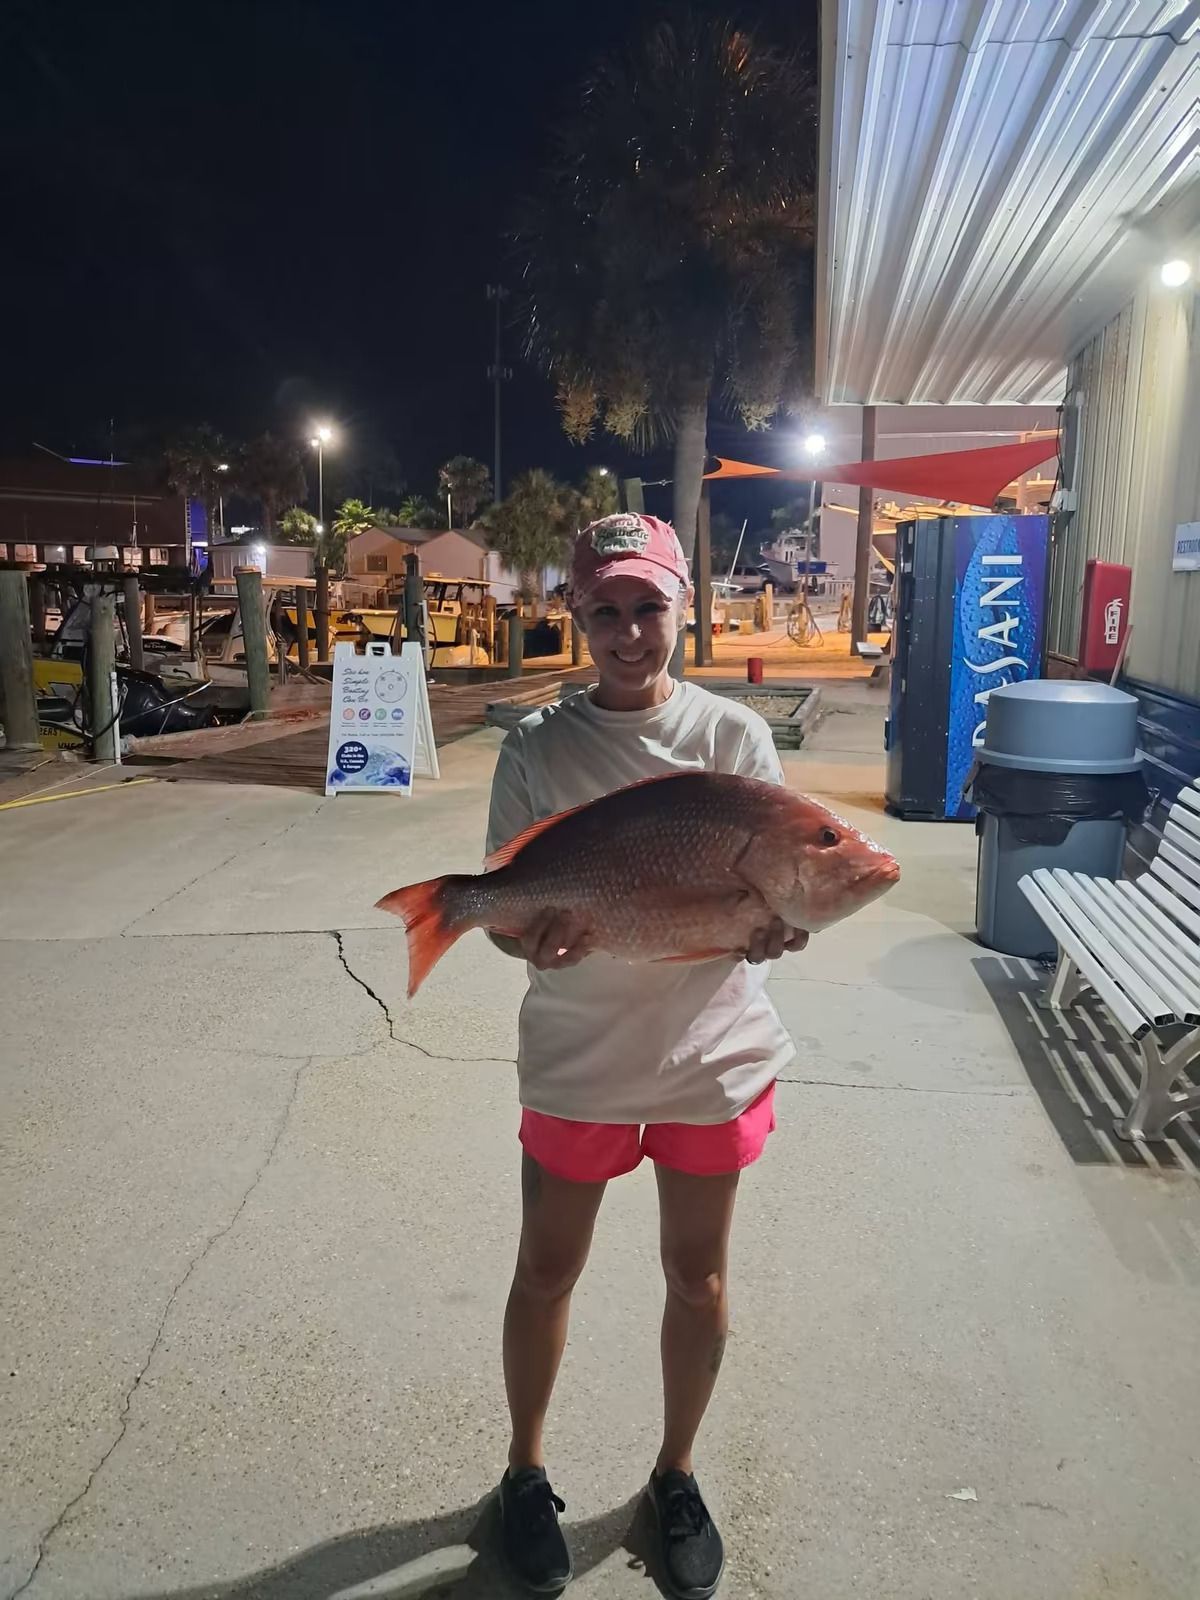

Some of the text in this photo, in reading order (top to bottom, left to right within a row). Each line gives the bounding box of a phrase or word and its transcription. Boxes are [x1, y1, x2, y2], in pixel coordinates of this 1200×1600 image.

[1108, 610, 1118, 640] FIRE
[342, 677, 368, 686] Simple
[343, 686, 369, 697] Boating
